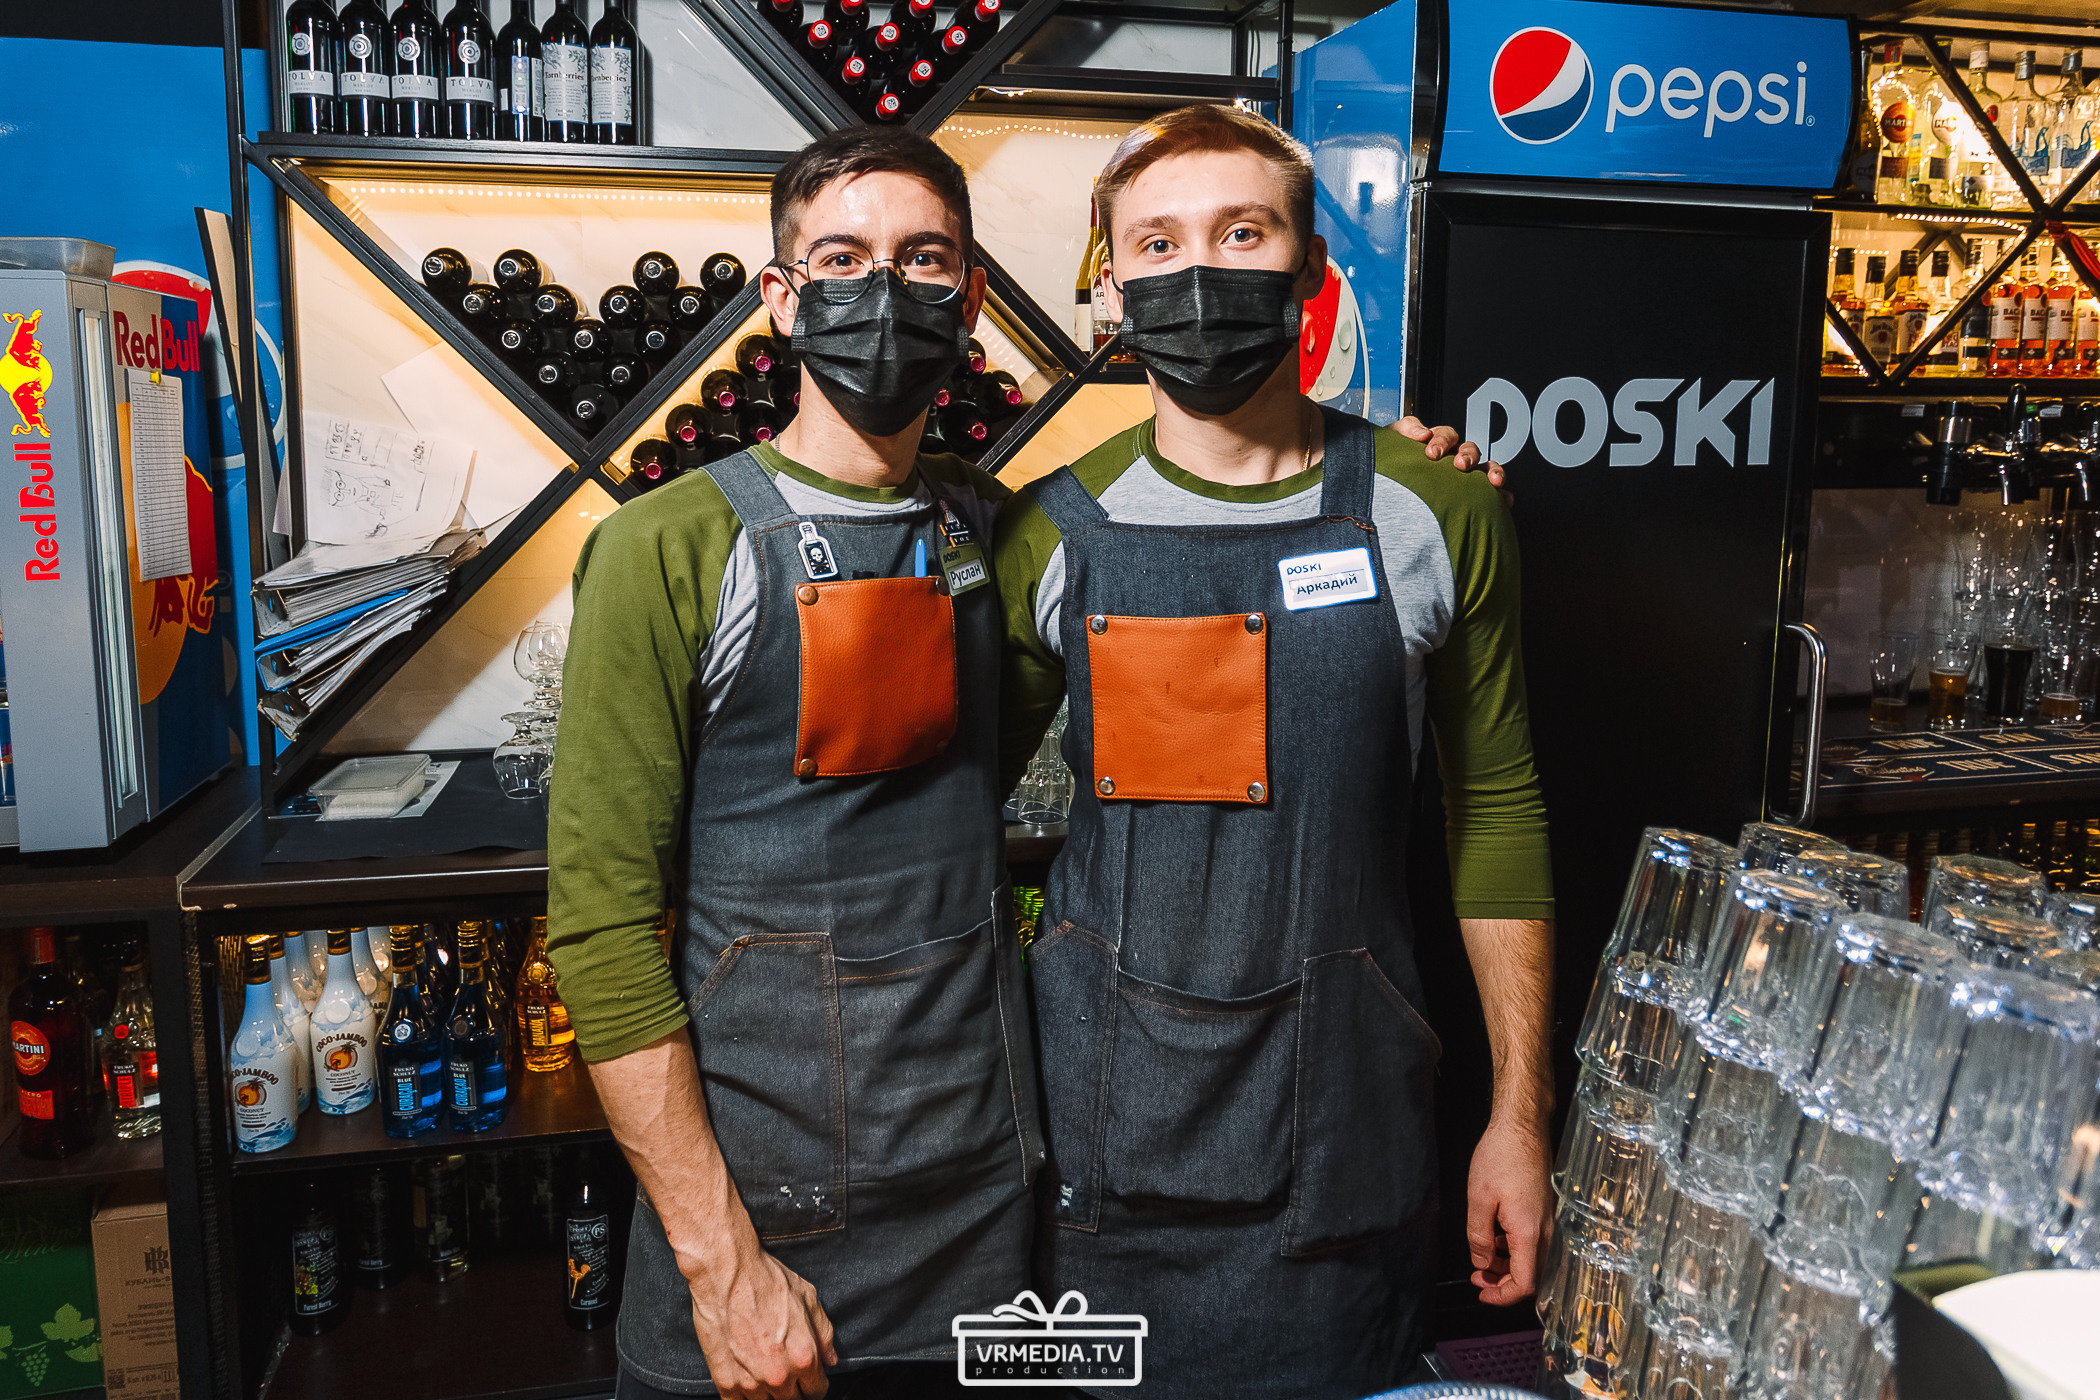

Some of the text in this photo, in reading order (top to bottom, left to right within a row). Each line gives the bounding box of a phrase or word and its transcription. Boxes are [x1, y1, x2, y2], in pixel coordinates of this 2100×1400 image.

[1605, 61, 1807, 138] pepsi
[113, 310, 200, 372] Red Bull
[1465, 376, 1774, 468] DOSKI
[13, 442, 61, 582] Red Bull
[950, 564, 982, 586] Руслан
[1286, 563, 1322, 575] DOSKI
[1297, 573, 1358, 595] Аркадий
